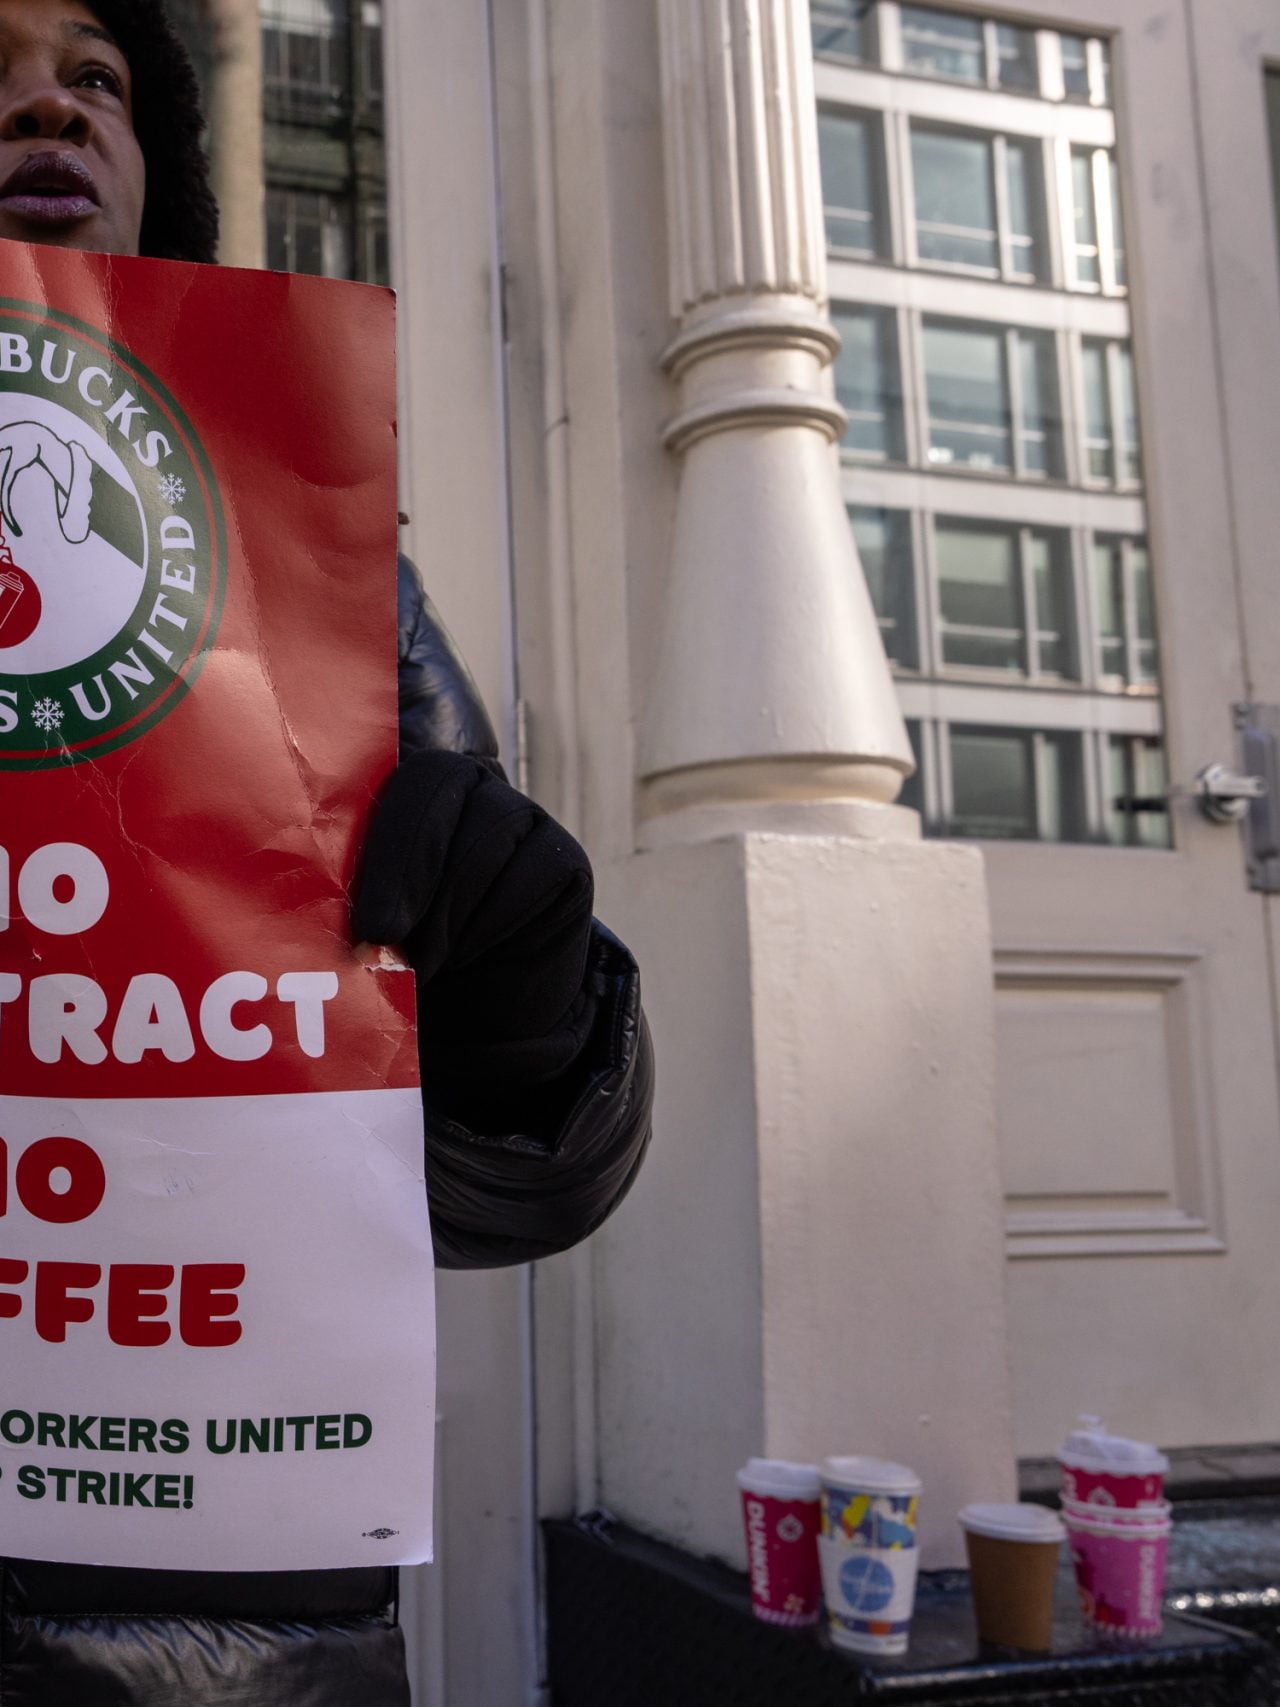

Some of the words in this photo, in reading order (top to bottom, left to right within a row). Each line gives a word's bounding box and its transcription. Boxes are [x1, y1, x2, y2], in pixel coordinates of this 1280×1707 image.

[68, 515, 196, 721] UNITED
[205, 1413, 373, 1455] UNITED
[16, 1465, 195, 1510] STRIKE!
